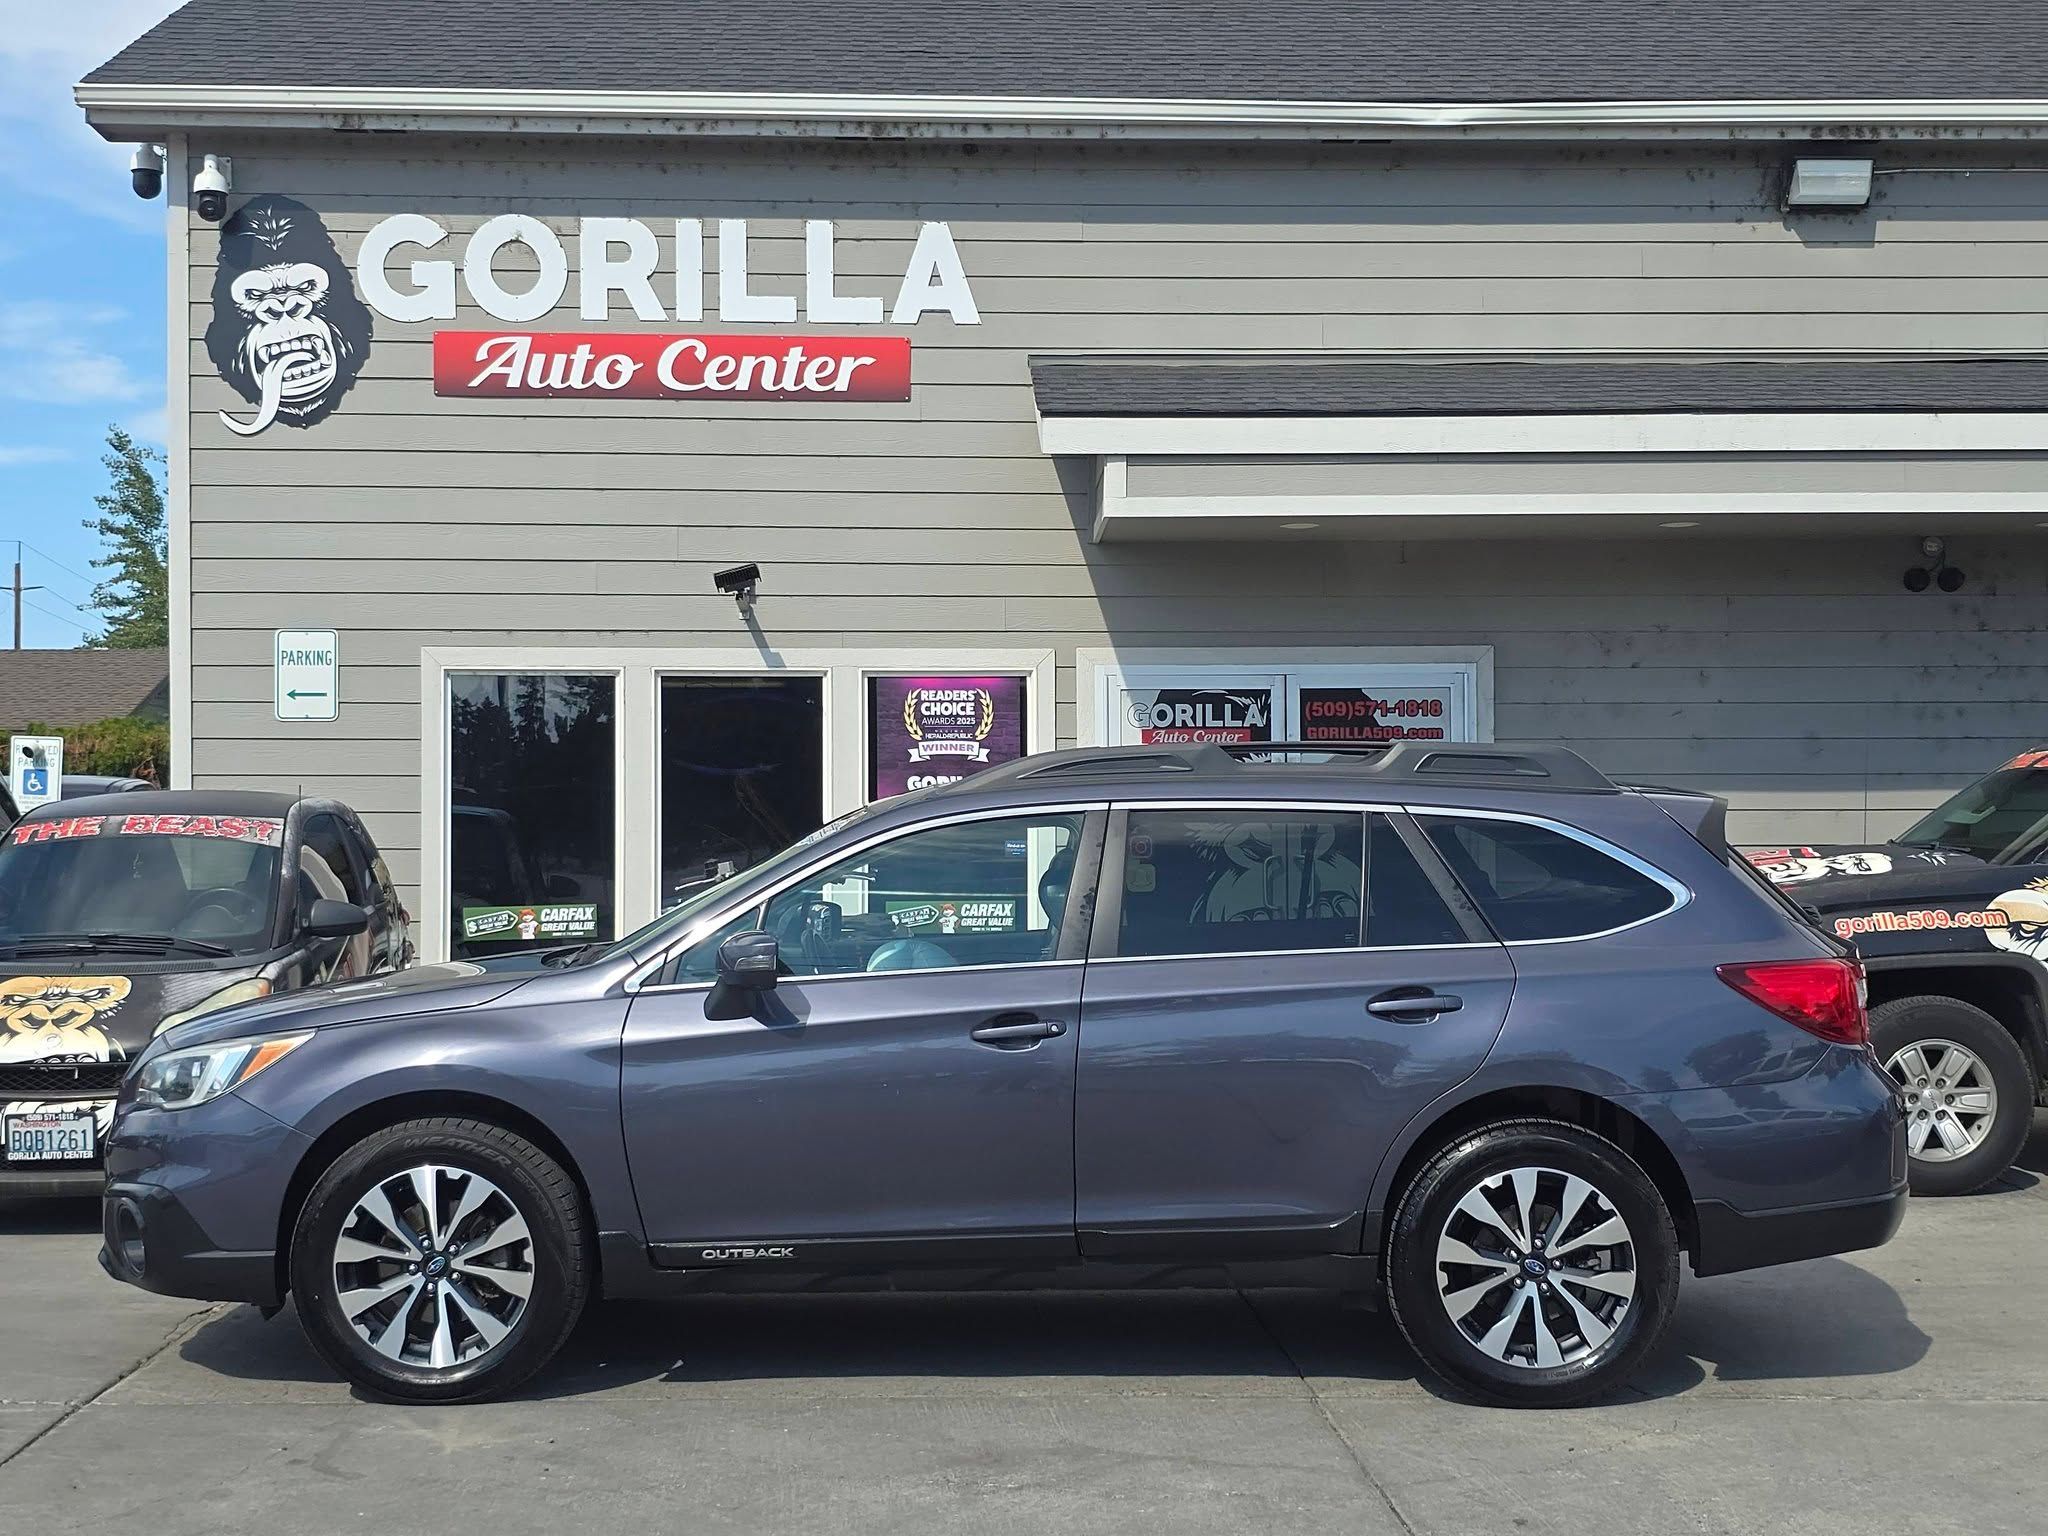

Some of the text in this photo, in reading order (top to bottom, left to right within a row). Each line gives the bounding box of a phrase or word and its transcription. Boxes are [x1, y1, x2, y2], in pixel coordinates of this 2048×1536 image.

[357, 213, 982, 325] GORILLA
[468, 336, 877, 392] Auto Center
[281, 650, 332, 666] PARKING
[921, 702, 975, 716] CHOICE
[1127, 702, 1265, 728] GORILLA
[1305, 700, 1443, 720] (509)571-1818
[922, 717, 976, 725] AWARDS 2025
[1151, 730, 1244, 744] Auto Center
[1306, 726, 1444, 740] GORILLA509.com
[921, 743, 975, 752] WINNER
[13, 815, 283, 845] THE BEAST
[541, 907, 595, 922] CARFAX
[961, 903, 1013, 917] CARFAX
[540, 923, 568, 932] GREAT
[568, 921, 596, 931] VALUE
[961, 918, 1014, 927] GREAT VALUE
[1835, 909, 2009, 939] gorilla509.com
[12, 1129, 88, 1152] BQB1261
[8, 1150, 94, 1160] GORILLA AUTO CENTER
[702, 1247, 794, 1259] OUTBACK
